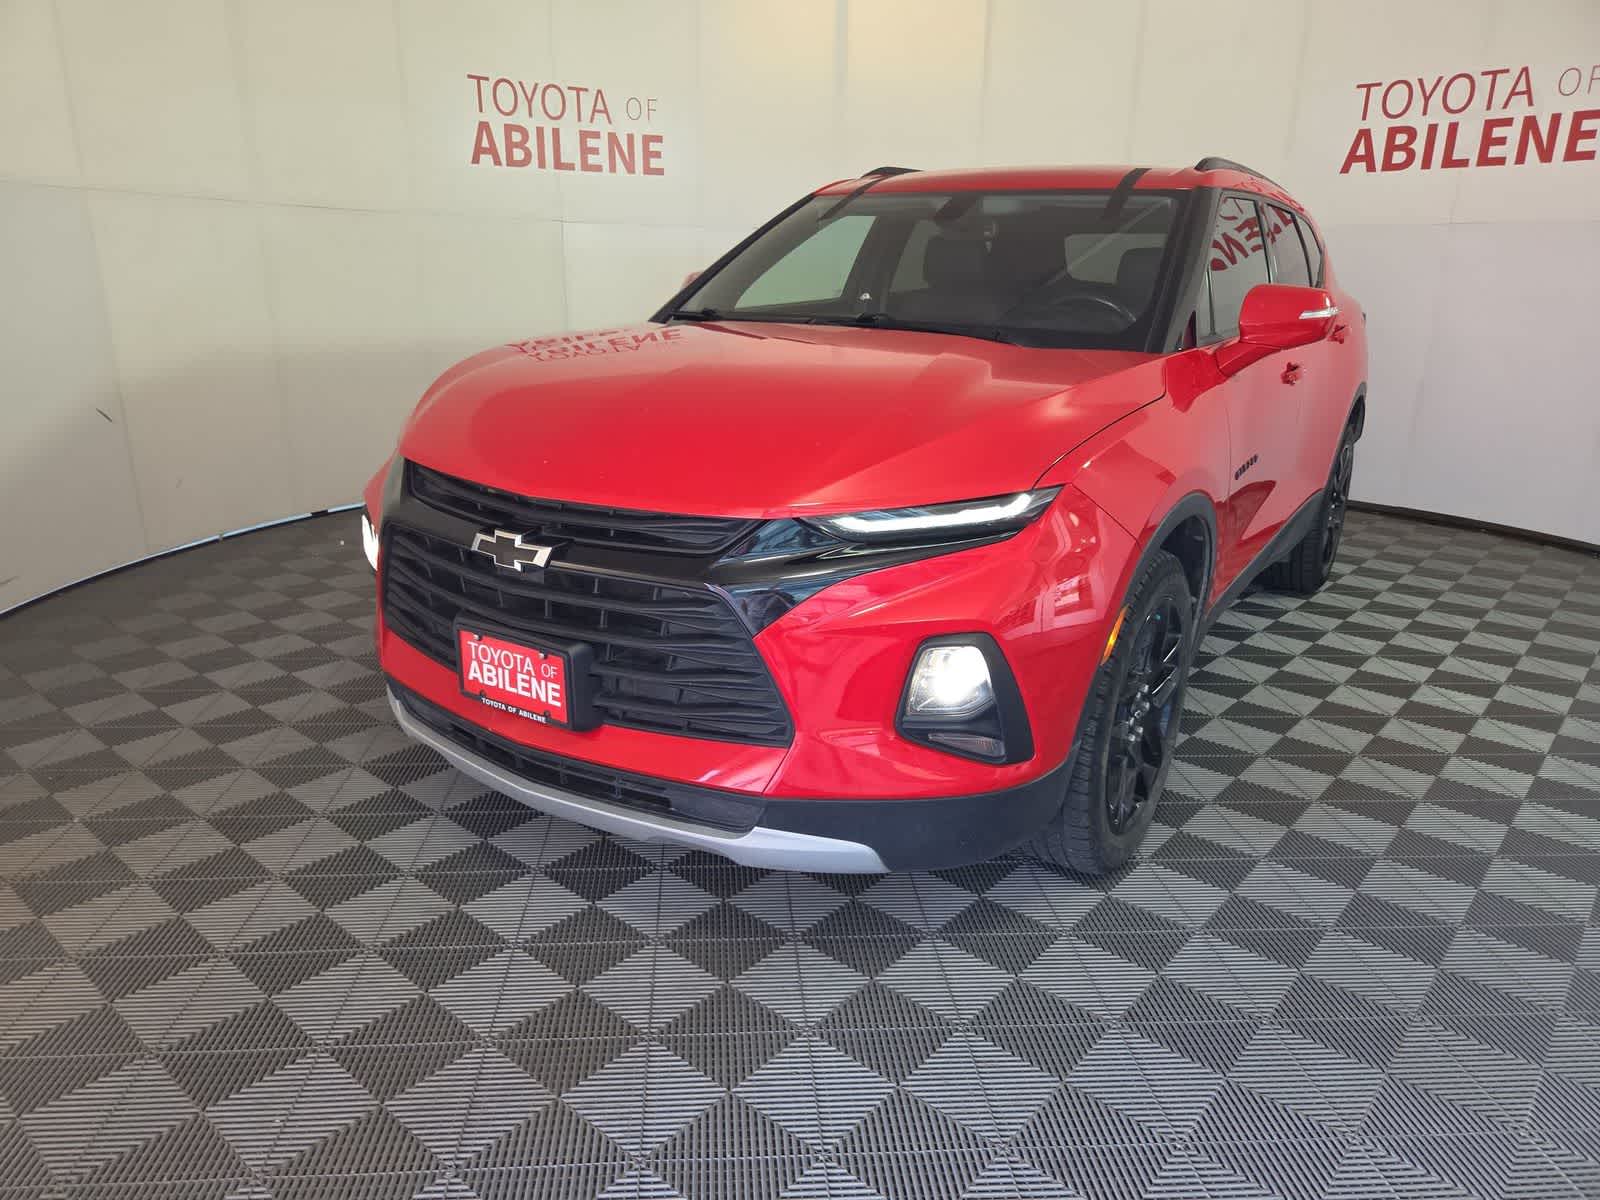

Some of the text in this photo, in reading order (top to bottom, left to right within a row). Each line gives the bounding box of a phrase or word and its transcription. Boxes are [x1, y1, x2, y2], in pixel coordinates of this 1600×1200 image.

[466, 74, 658, 125] TOYOTA OF
[1355, 66, 1534, 121] TOYOTA
[471, 120, 665, 176] ABILENE
[1339, 108, 1600, 174] ABILENE
[467, 641, 558, 679] TOYOTA OF
[468, 660, 562, 707] ABILENE
[481, 697, 547, 724] TOYOTA OF ABILENE
